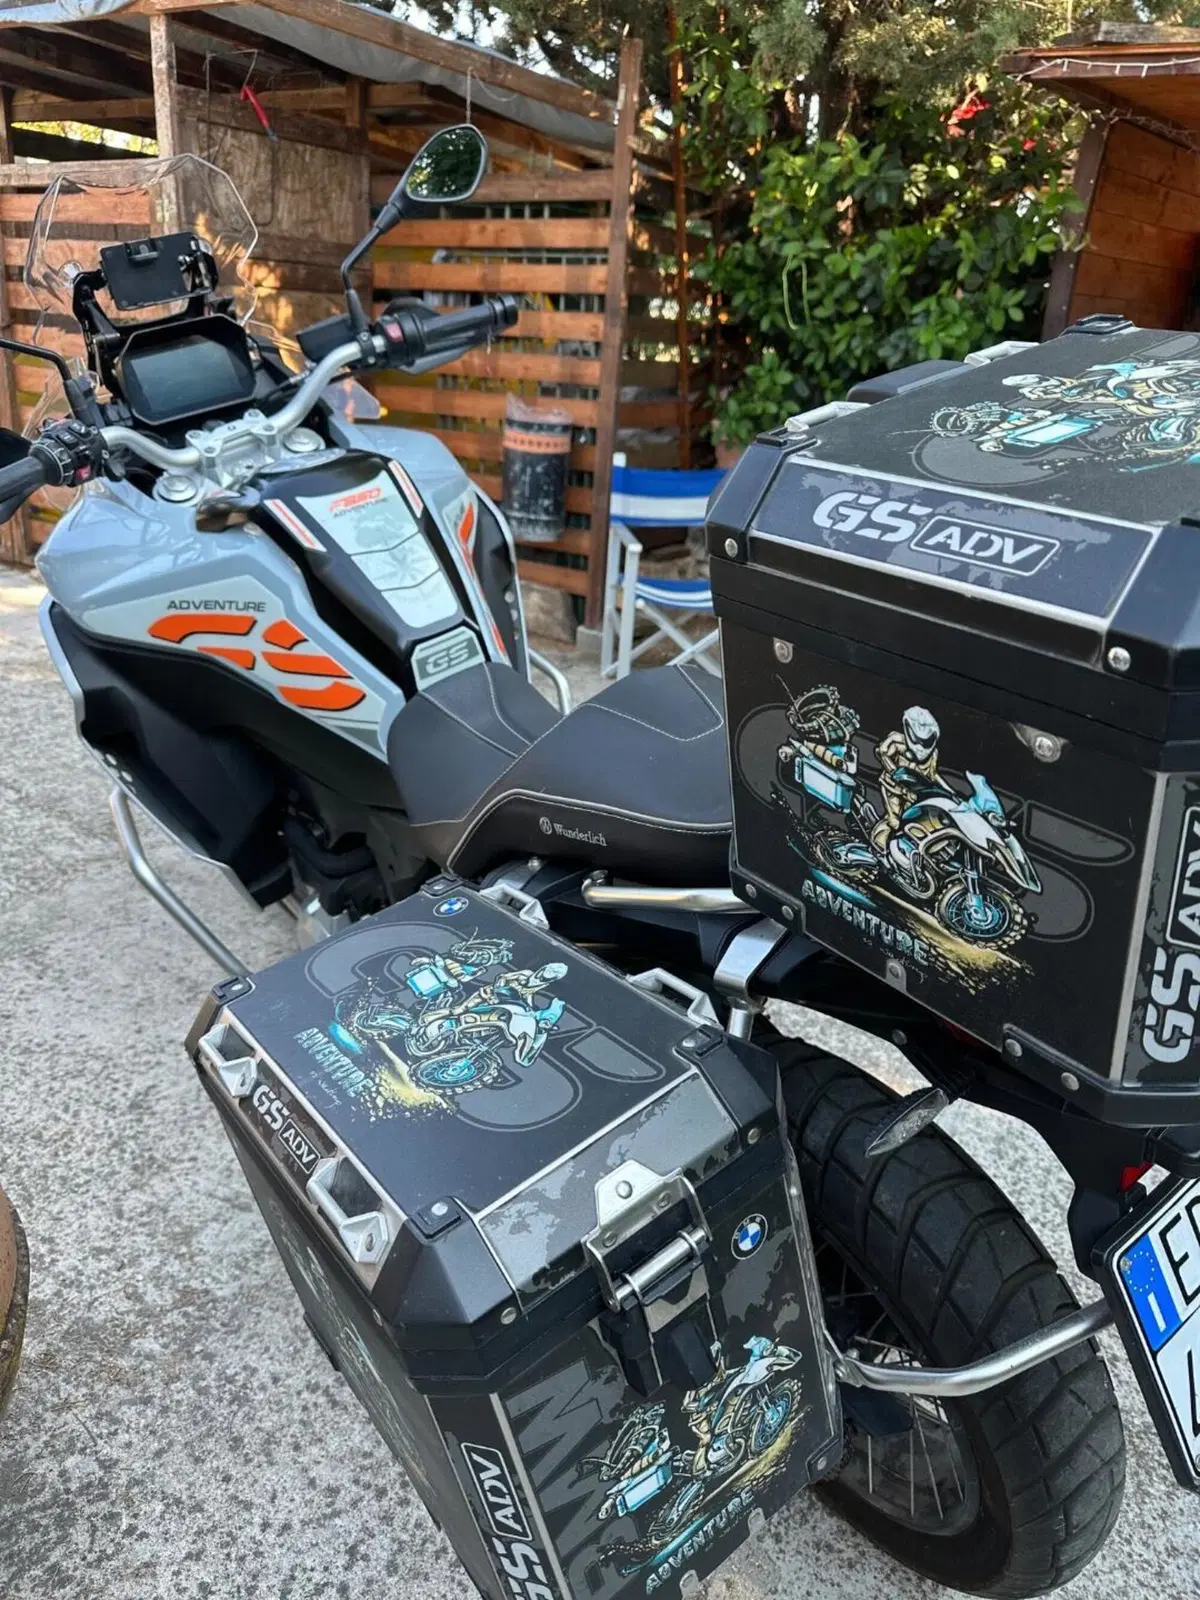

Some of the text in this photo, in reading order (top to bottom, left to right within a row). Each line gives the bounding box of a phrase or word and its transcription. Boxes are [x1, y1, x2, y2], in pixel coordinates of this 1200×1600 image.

[812, 491, 1045, 565] GS ADV
[166, 599, 267, 613] ADVENTURE
[425, 641, 469, 675] GS
[553, 822, 608, 847] Wunderlich
[801, 878, 929, 967] ADVENTURE
[1143, 946, 1200, 1063] GS
[293, 1027, 375, 1099] ADVENTURE
[252, 1084, 317, 1164] GS ADV
[470, 1451, 524, 1533] ADV
[646, 1484, 755, 1597] ADVENTURE
